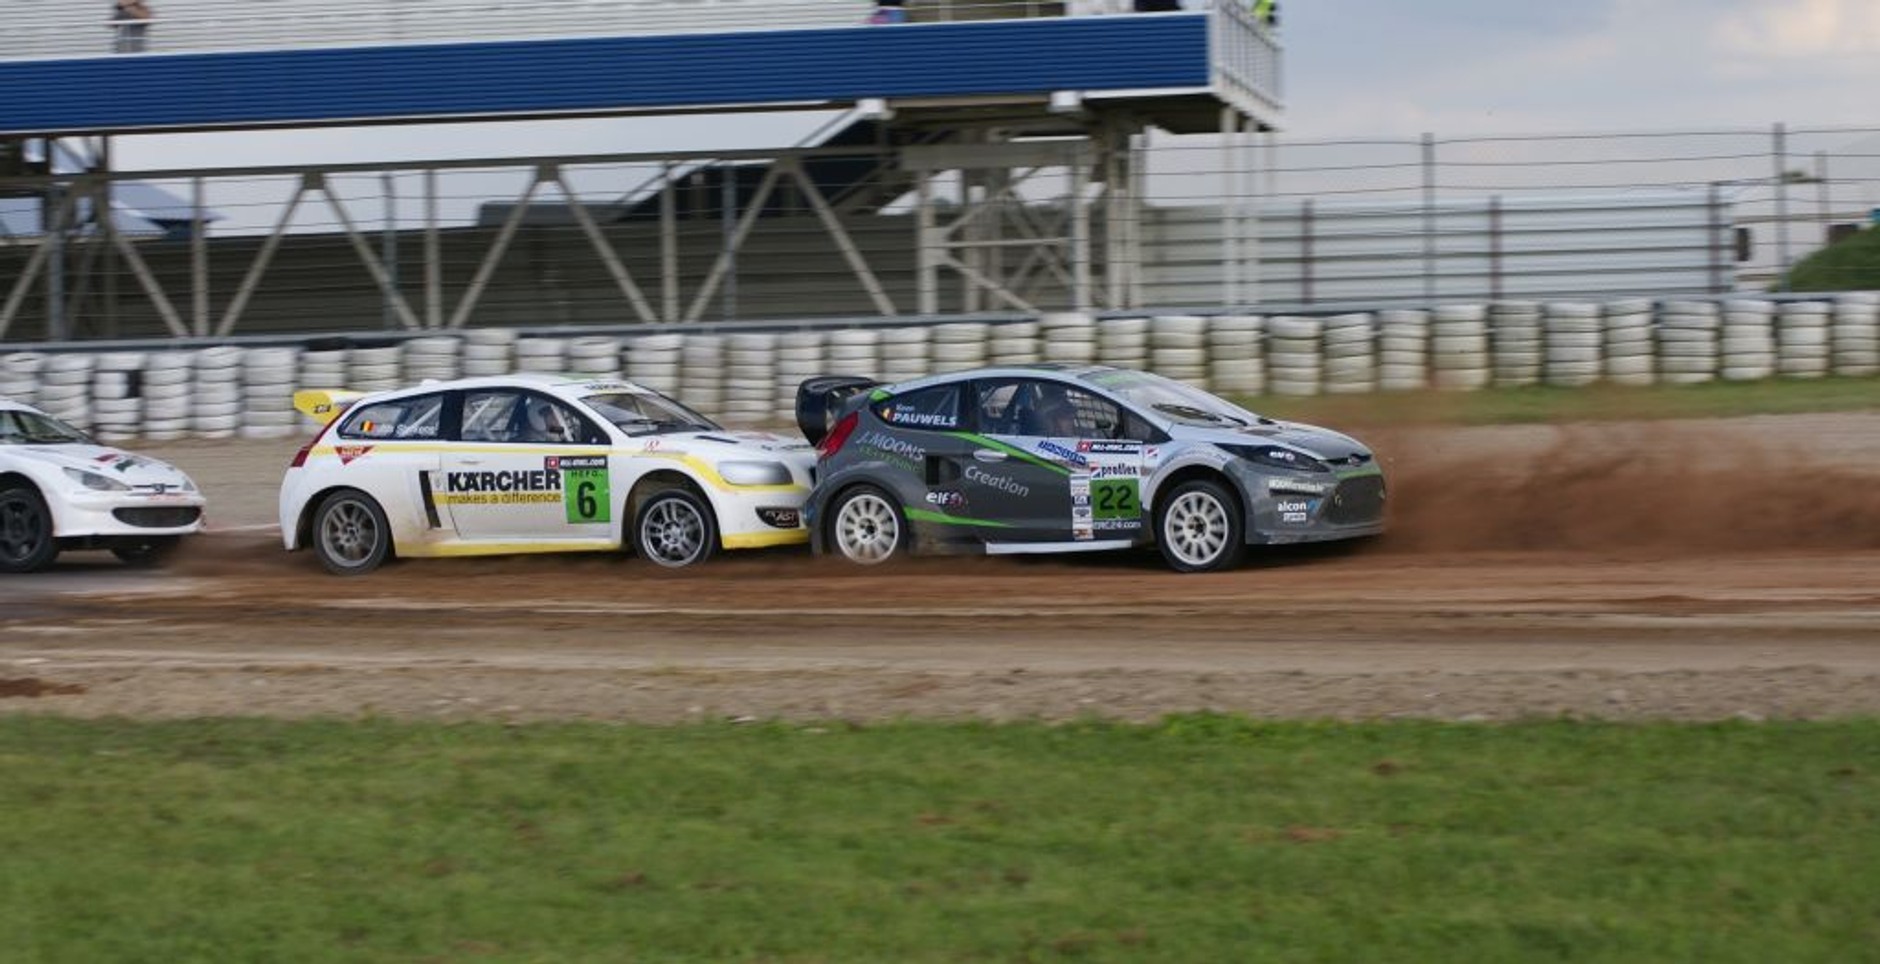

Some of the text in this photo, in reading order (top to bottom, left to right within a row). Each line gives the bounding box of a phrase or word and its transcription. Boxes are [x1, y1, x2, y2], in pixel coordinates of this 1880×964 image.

[892, 413, 957, 427] PAUWELS
[448, 470, 561, 492] KÄRCHER
[965, 465, 1030, 498] Creation
[448, 492, 562, 505] makes a difference
[577, 481, 597, 519] 6
[925, 491, 949, 505] elf
[1099, 485, 1133, 511] 22
[1277, 501, 1307, 512] alcon
